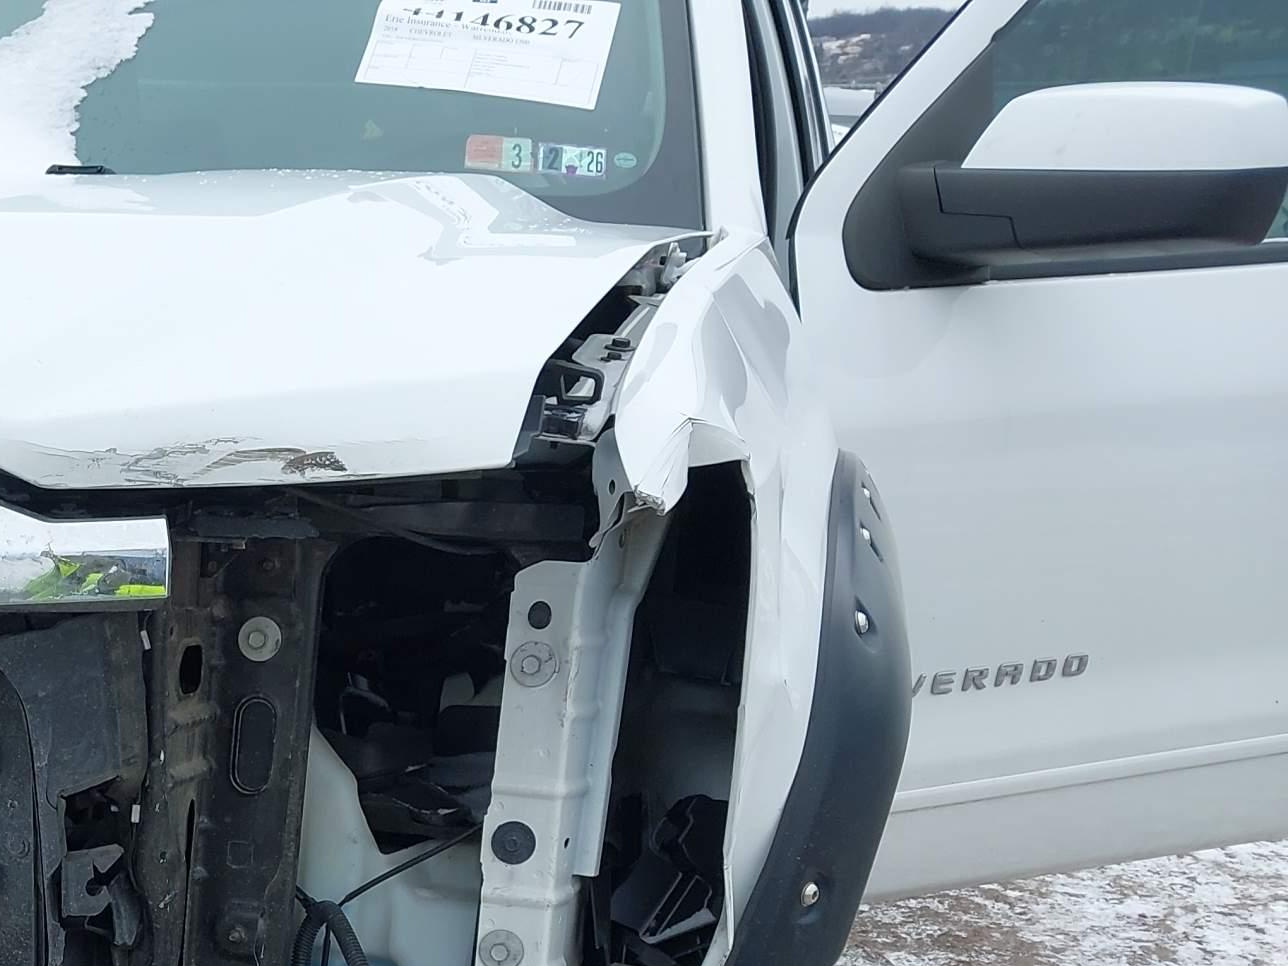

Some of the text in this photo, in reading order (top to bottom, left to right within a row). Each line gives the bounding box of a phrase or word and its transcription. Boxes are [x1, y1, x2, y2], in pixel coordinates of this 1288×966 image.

[406, 16, 452, 29] Insurance
[511, 144, 523, 169] 3
[548, 149, 604, 174] 2 26
